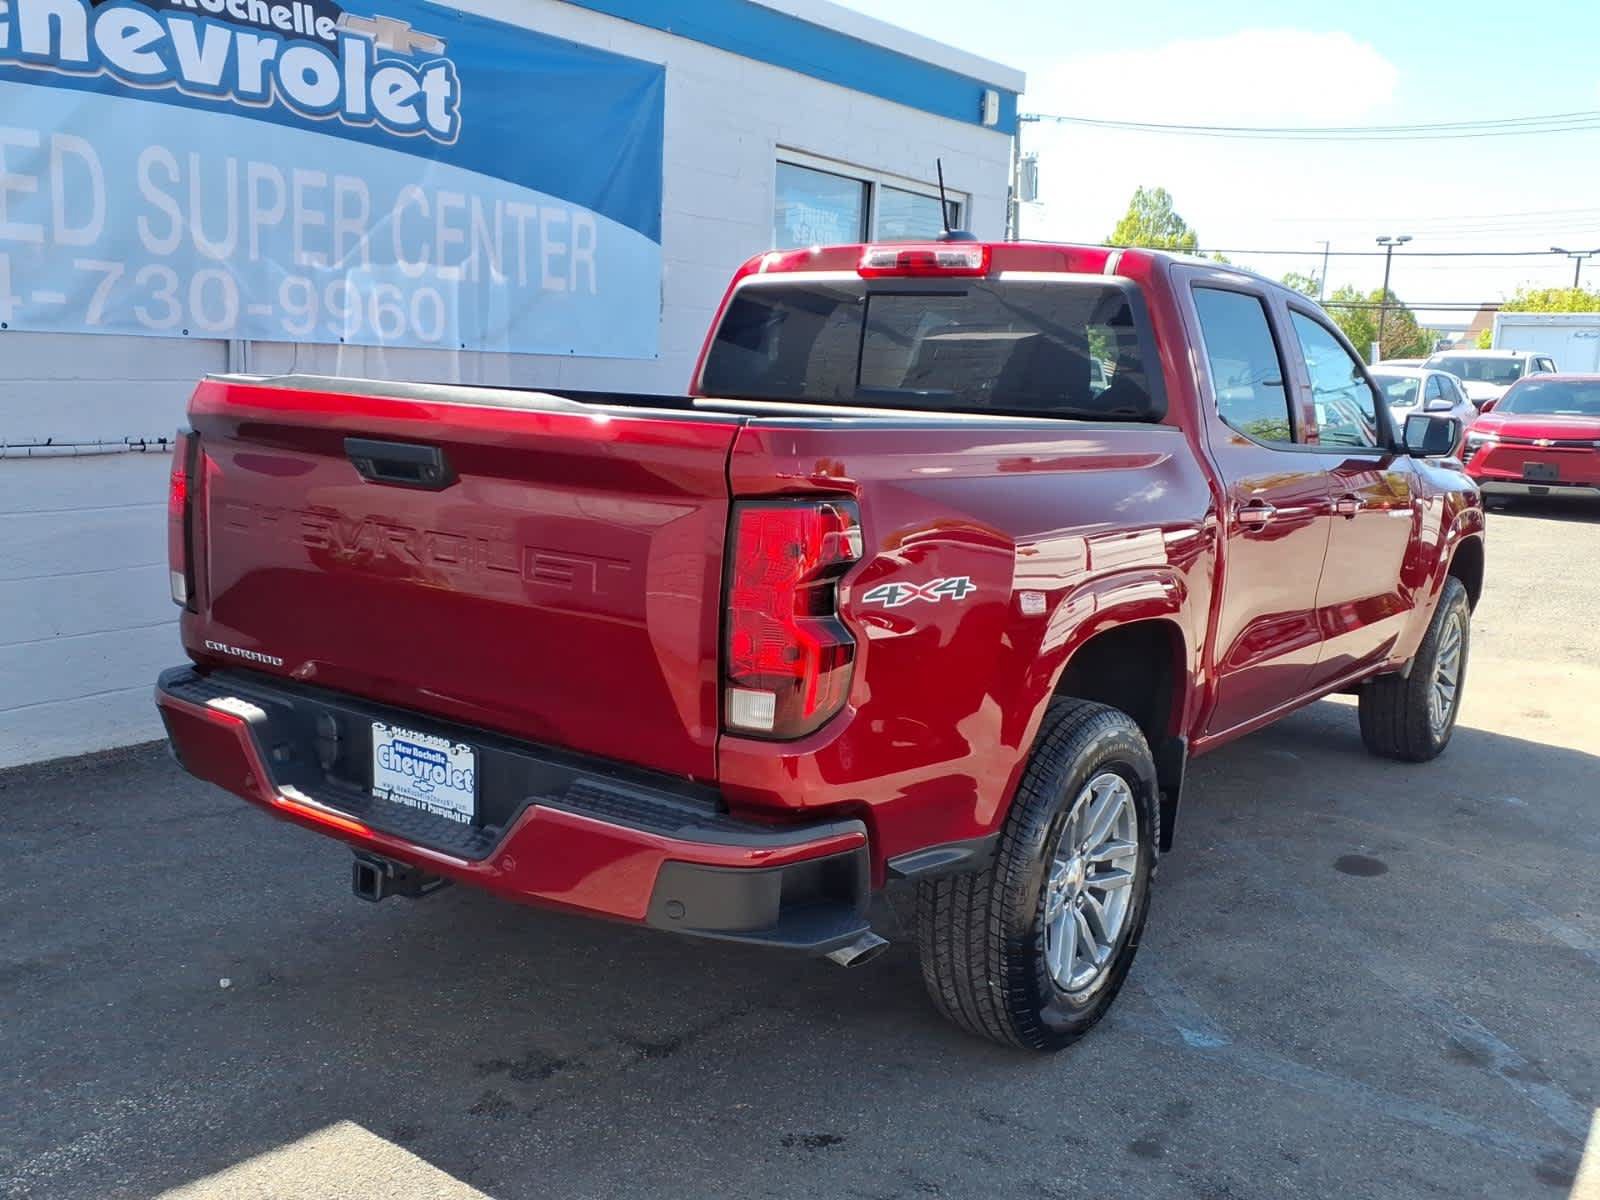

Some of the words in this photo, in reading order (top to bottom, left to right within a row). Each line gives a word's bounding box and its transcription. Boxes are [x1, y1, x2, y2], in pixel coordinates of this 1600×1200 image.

[170, 0, 337, 40] ochelle
[0, 0, 452, 133] hevrolet
[137, 144, 371, 272] SUPER
[392, 183, 597, 295] CENTER
[222, 501, 632, 593] EVROLET
[205, 640, 284, 667] COLORADO
[377, 743, 474, 793] Chevrolet
